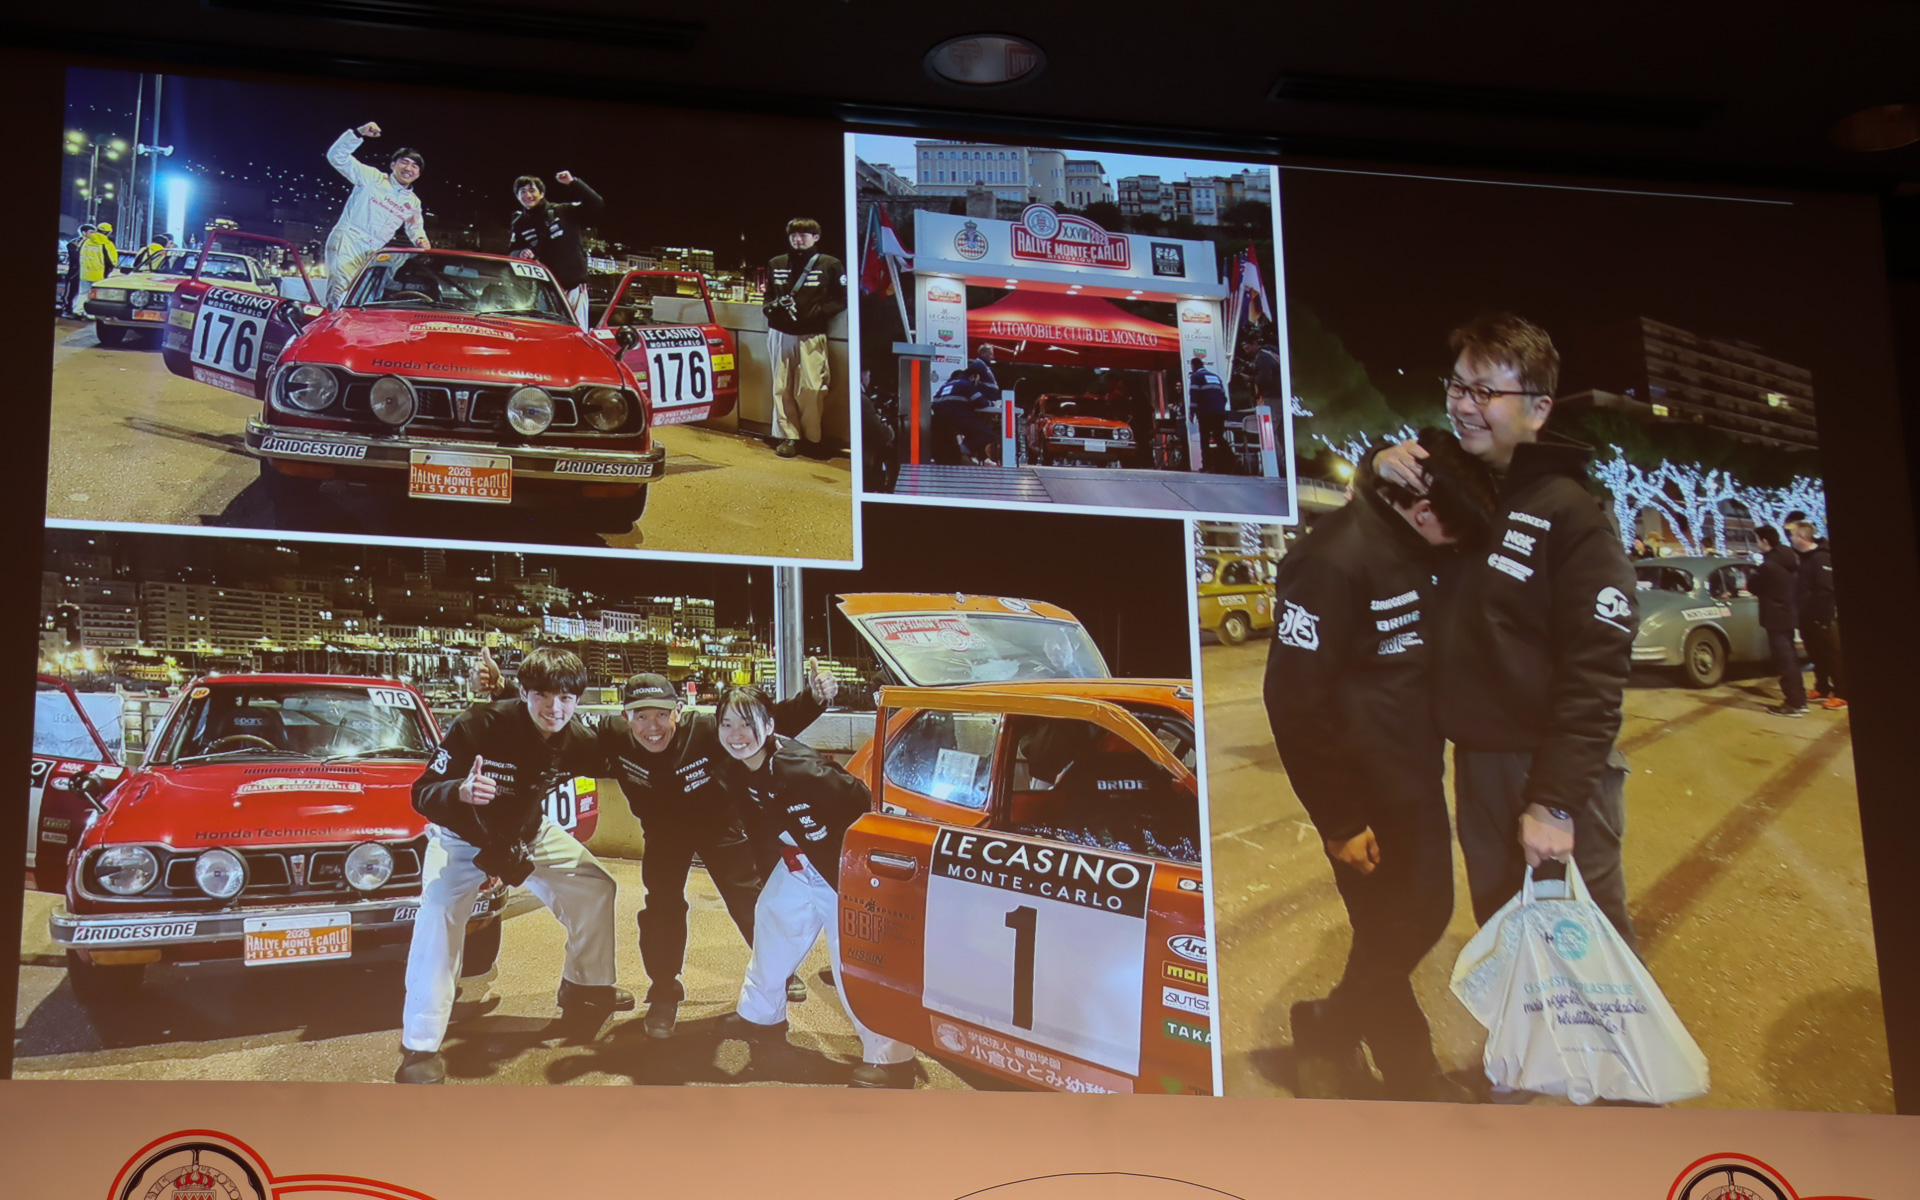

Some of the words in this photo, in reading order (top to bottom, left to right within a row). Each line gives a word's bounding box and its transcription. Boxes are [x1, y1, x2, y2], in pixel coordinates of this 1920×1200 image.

[1017, 230, 1052, 255] RALLYE
[1054, 242, 1125, 262] MONTE-CARLO
[516, 264, 545, 279] 176
[208, 288, 220, 299] LE
[221, 289, 271, 309] CASINO
[199, 311, 257, 373] 176
[643, 330, 655, 340] LE
[655, 328, 700, 340] CASINO
[989, 322, 1062, 340] AUTOMOBILE
[1064, 326, 1093, 342] CLUB
[1095, 329, 1109, 343] DE
[1112, 330, 1158, 346] MONACO
[372, 358, 422, 370] Honda
[425, 361, 496, 375] Technical
[497, 369, 552, 382] College
[653, 350, 706, 403] 176
[263, 437, 366, 458] BRIDGESTONE
[410, 466, 442, 485] RALLYE
[444, 472, 508, 488] MONTE-CARLO
[448, 466, 472, 477] 2026
[555, 459, 652, 476] BRIDGESTONE
[410, 483, 507, 497] HISTORIQUE
[1504, 529, 1536, 551] NGK
[1376, 610, 1421, 632] BRIDE
[376, 690, 410, 707] 176
[633, 687, 664, 695] HONDA
[675, 757, 709, 775] HONDA
[195, 829, 252, 841] Honda
[257, 827, 332, 838] Technical
[941, 832, 977, 859] LE
[982, 840, 1140, 890] CASINO
[74, 922, 196, 942] BRIDGESTONE
[285, 928, 310, 939] 2026
[843, 907, 883, 944] BBF
[246, 933, 280, 951] RALLYE
[282, 927, 348, 949] MONTE-CARLO
[1171, 938, 1207, 956] Ara
[246, 943, 348, 960] HISTORIQUE
[848, 947, 884, 965] NISSIN
[1004, 904, 1038, 1032] 1
[1167, 965, 1209, 984] mom
[968, 1031, 1011, 1054] 学校法人
[970, 1045, 1120, 1094] 小倉ひとみ幼稚
